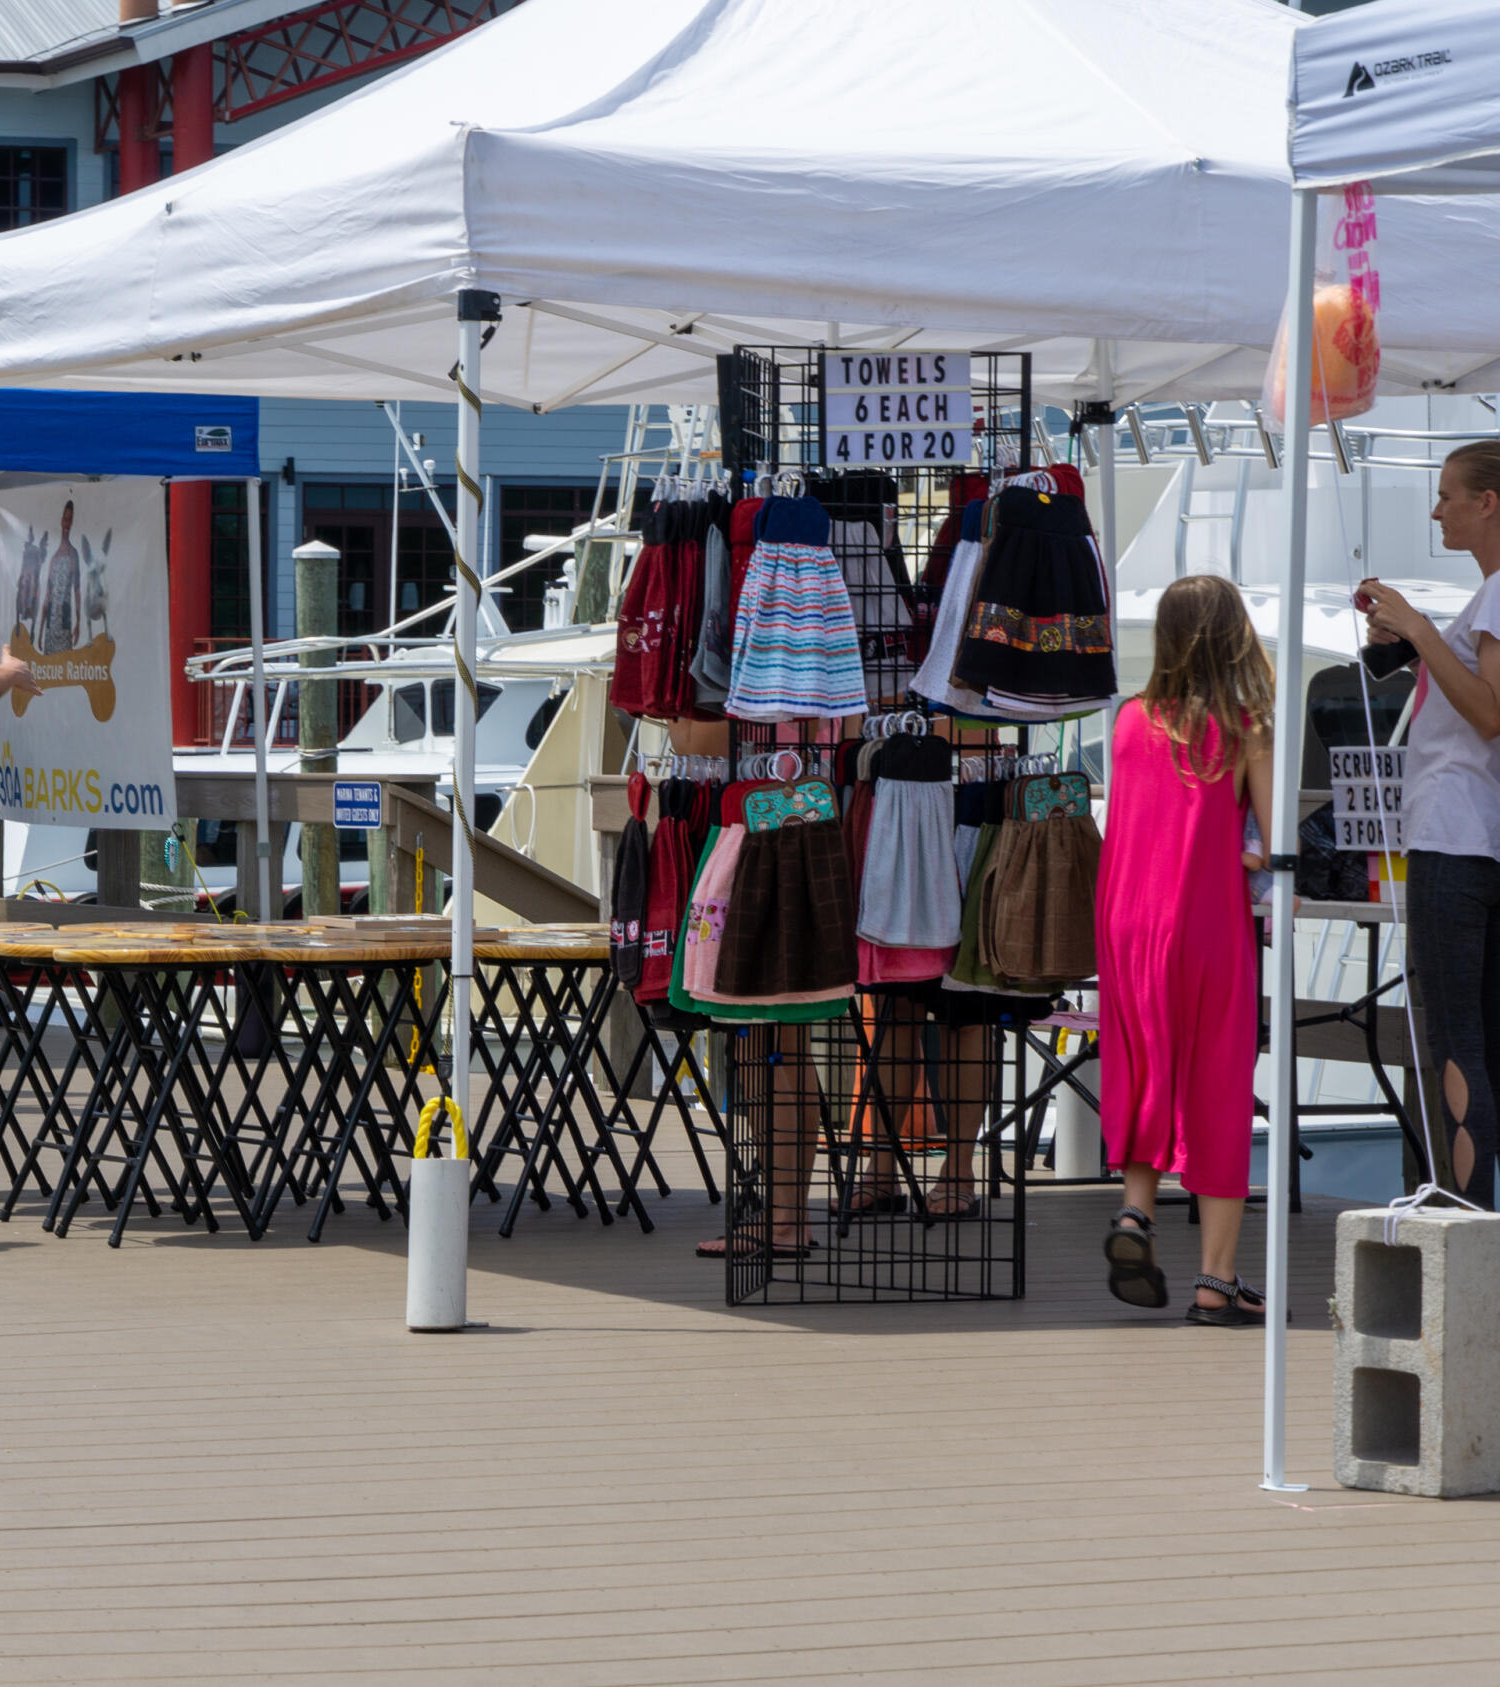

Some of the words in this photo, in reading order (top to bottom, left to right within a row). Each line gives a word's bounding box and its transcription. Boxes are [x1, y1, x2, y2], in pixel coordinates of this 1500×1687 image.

[841, 355, 946, 386] TOWELS
[855, 395, 868, 423] 6
[880, 394, 948, 422] EACH
[836, 434, 850, 462] 4
[864, 432, 913, 461] FOR
[923, 431, 955, 459] 20
[30, 661, 64, 680] Rescue
[66, 660, 108, 680] Rations
[1347, 787, 1355, 811] 2
[1343, 821, 1352, 845] 3
